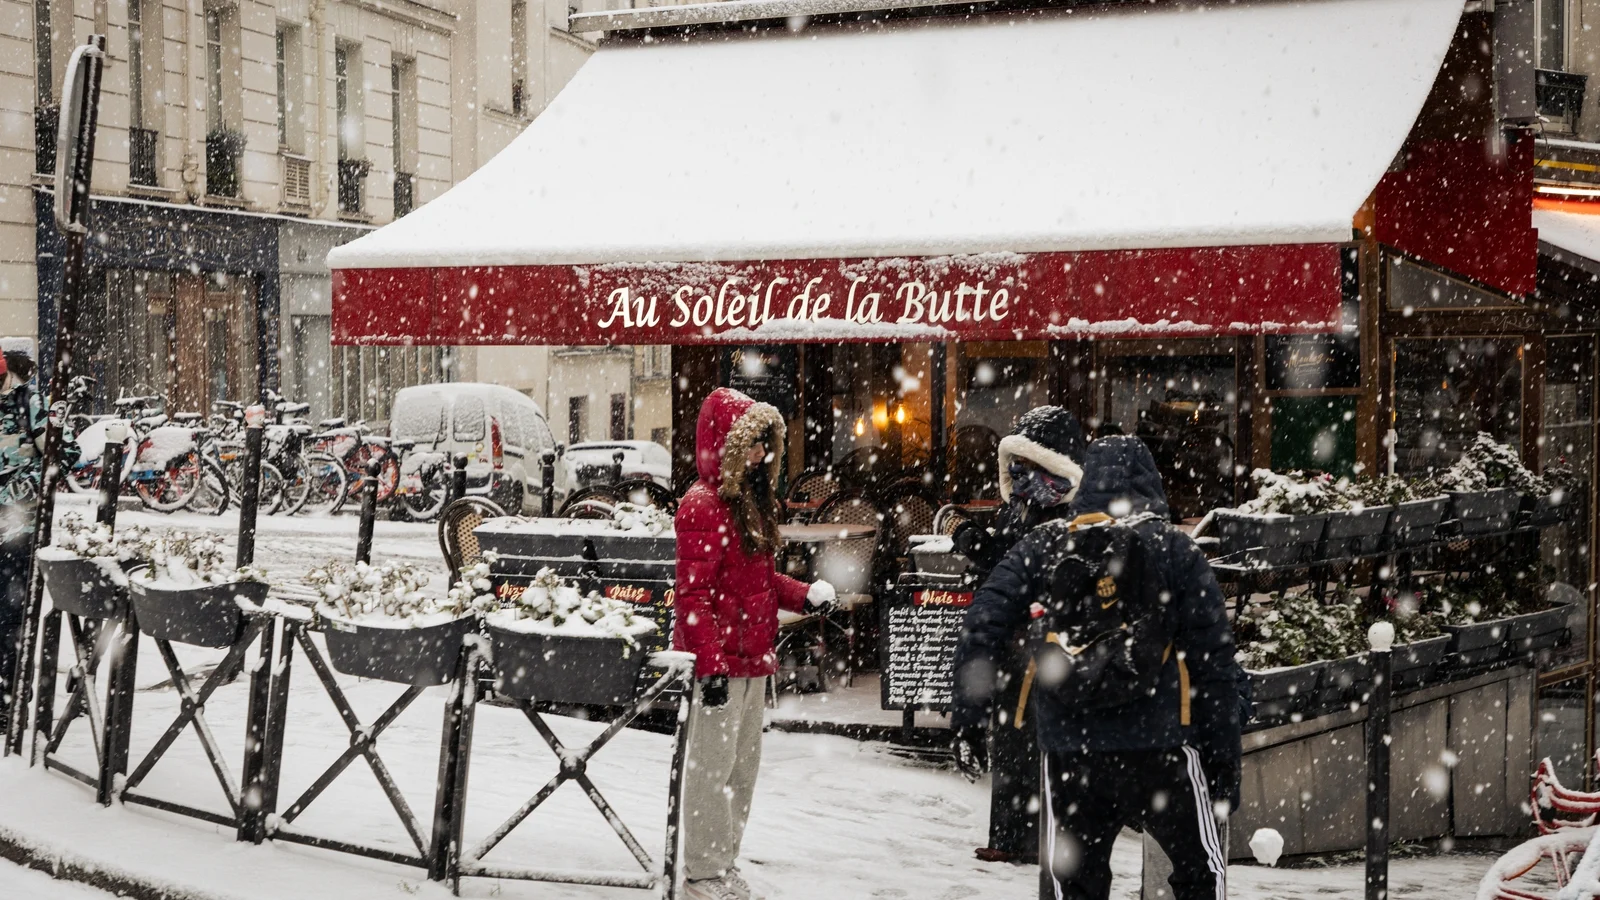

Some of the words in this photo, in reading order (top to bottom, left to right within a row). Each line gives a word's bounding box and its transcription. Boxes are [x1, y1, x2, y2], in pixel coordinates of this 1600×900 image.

[597, 286, 661, 328] Au
[669, 277, 786, 328] Soleil
[787, 276, 831, 323] de
[845, 275, 884, 324] la
[895, 281, 1009, 324] Butte
